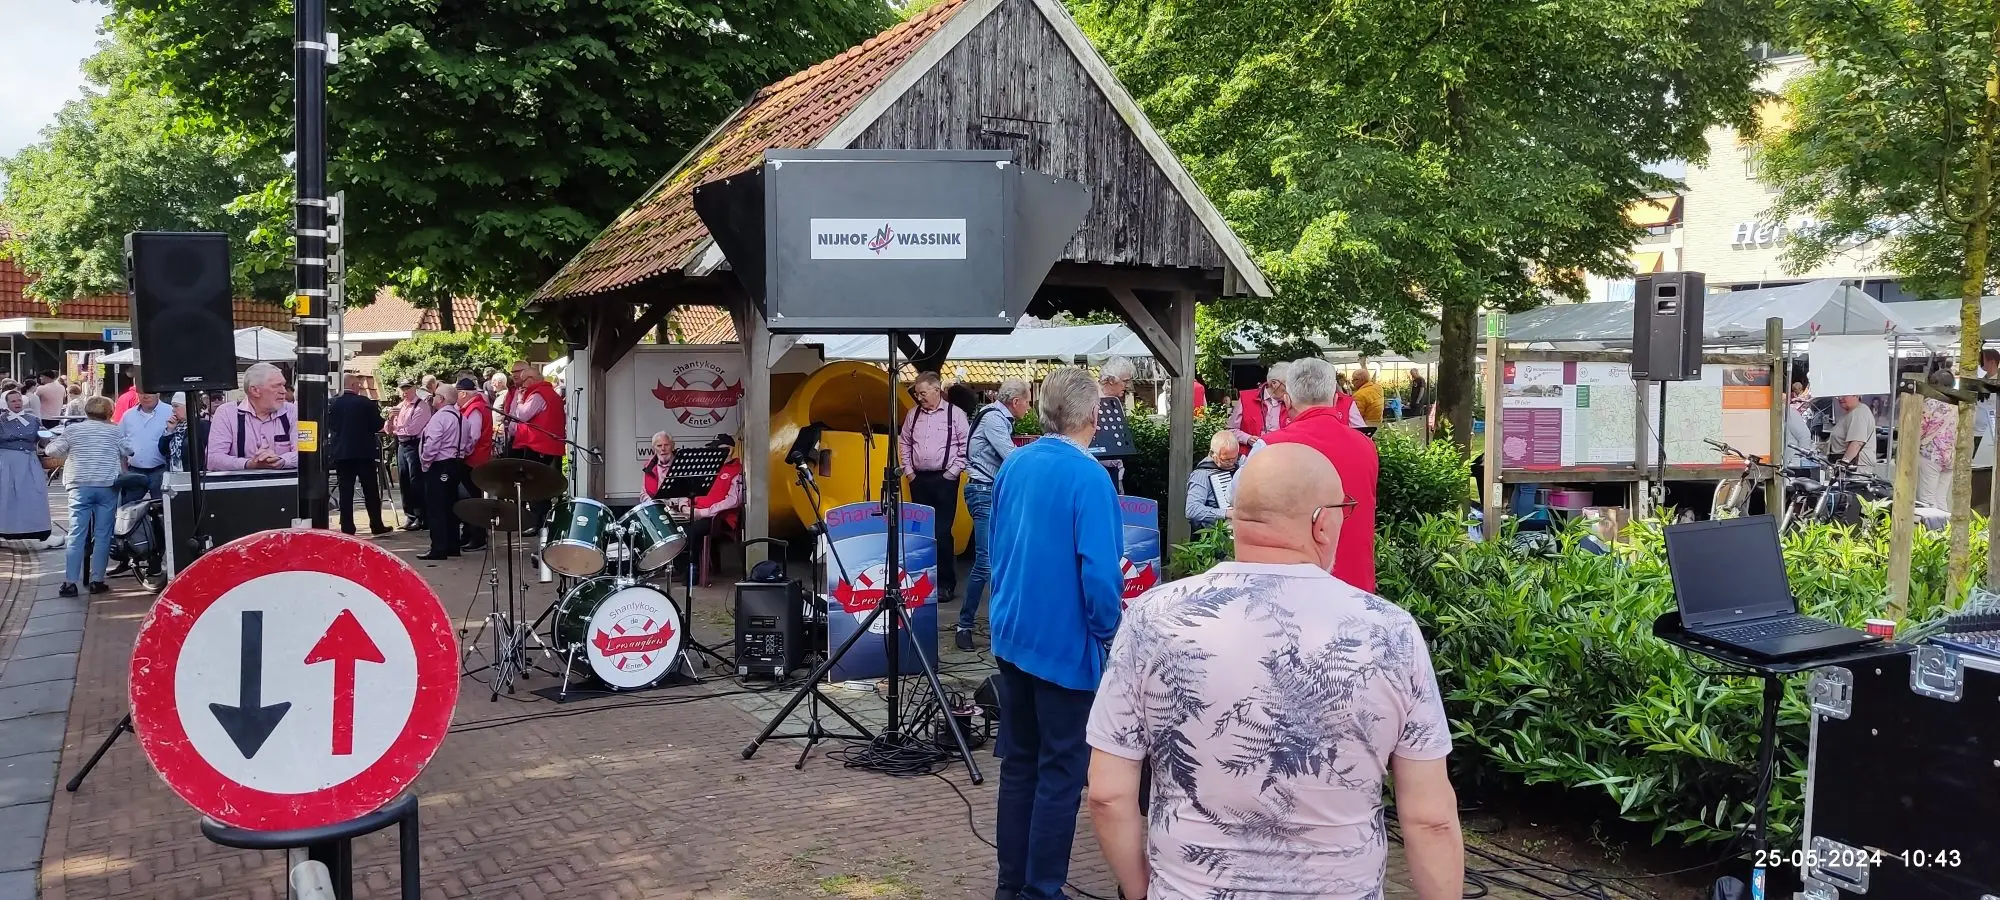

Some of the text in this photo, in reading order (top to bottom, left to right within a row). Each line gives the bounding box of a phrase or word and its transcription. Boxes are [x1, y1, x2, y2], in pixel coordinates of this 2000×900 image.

[818, 233, 961, 246] NIJHOF WASSINK
[673, 360, 725, 376] Shantykoor
[688, 417, 712, 426] Enter
[826, 503, 933, 528] Shantoor
[609, 602, 658, 619] Shantykoor
[625, 662, 644, 670] Enter
